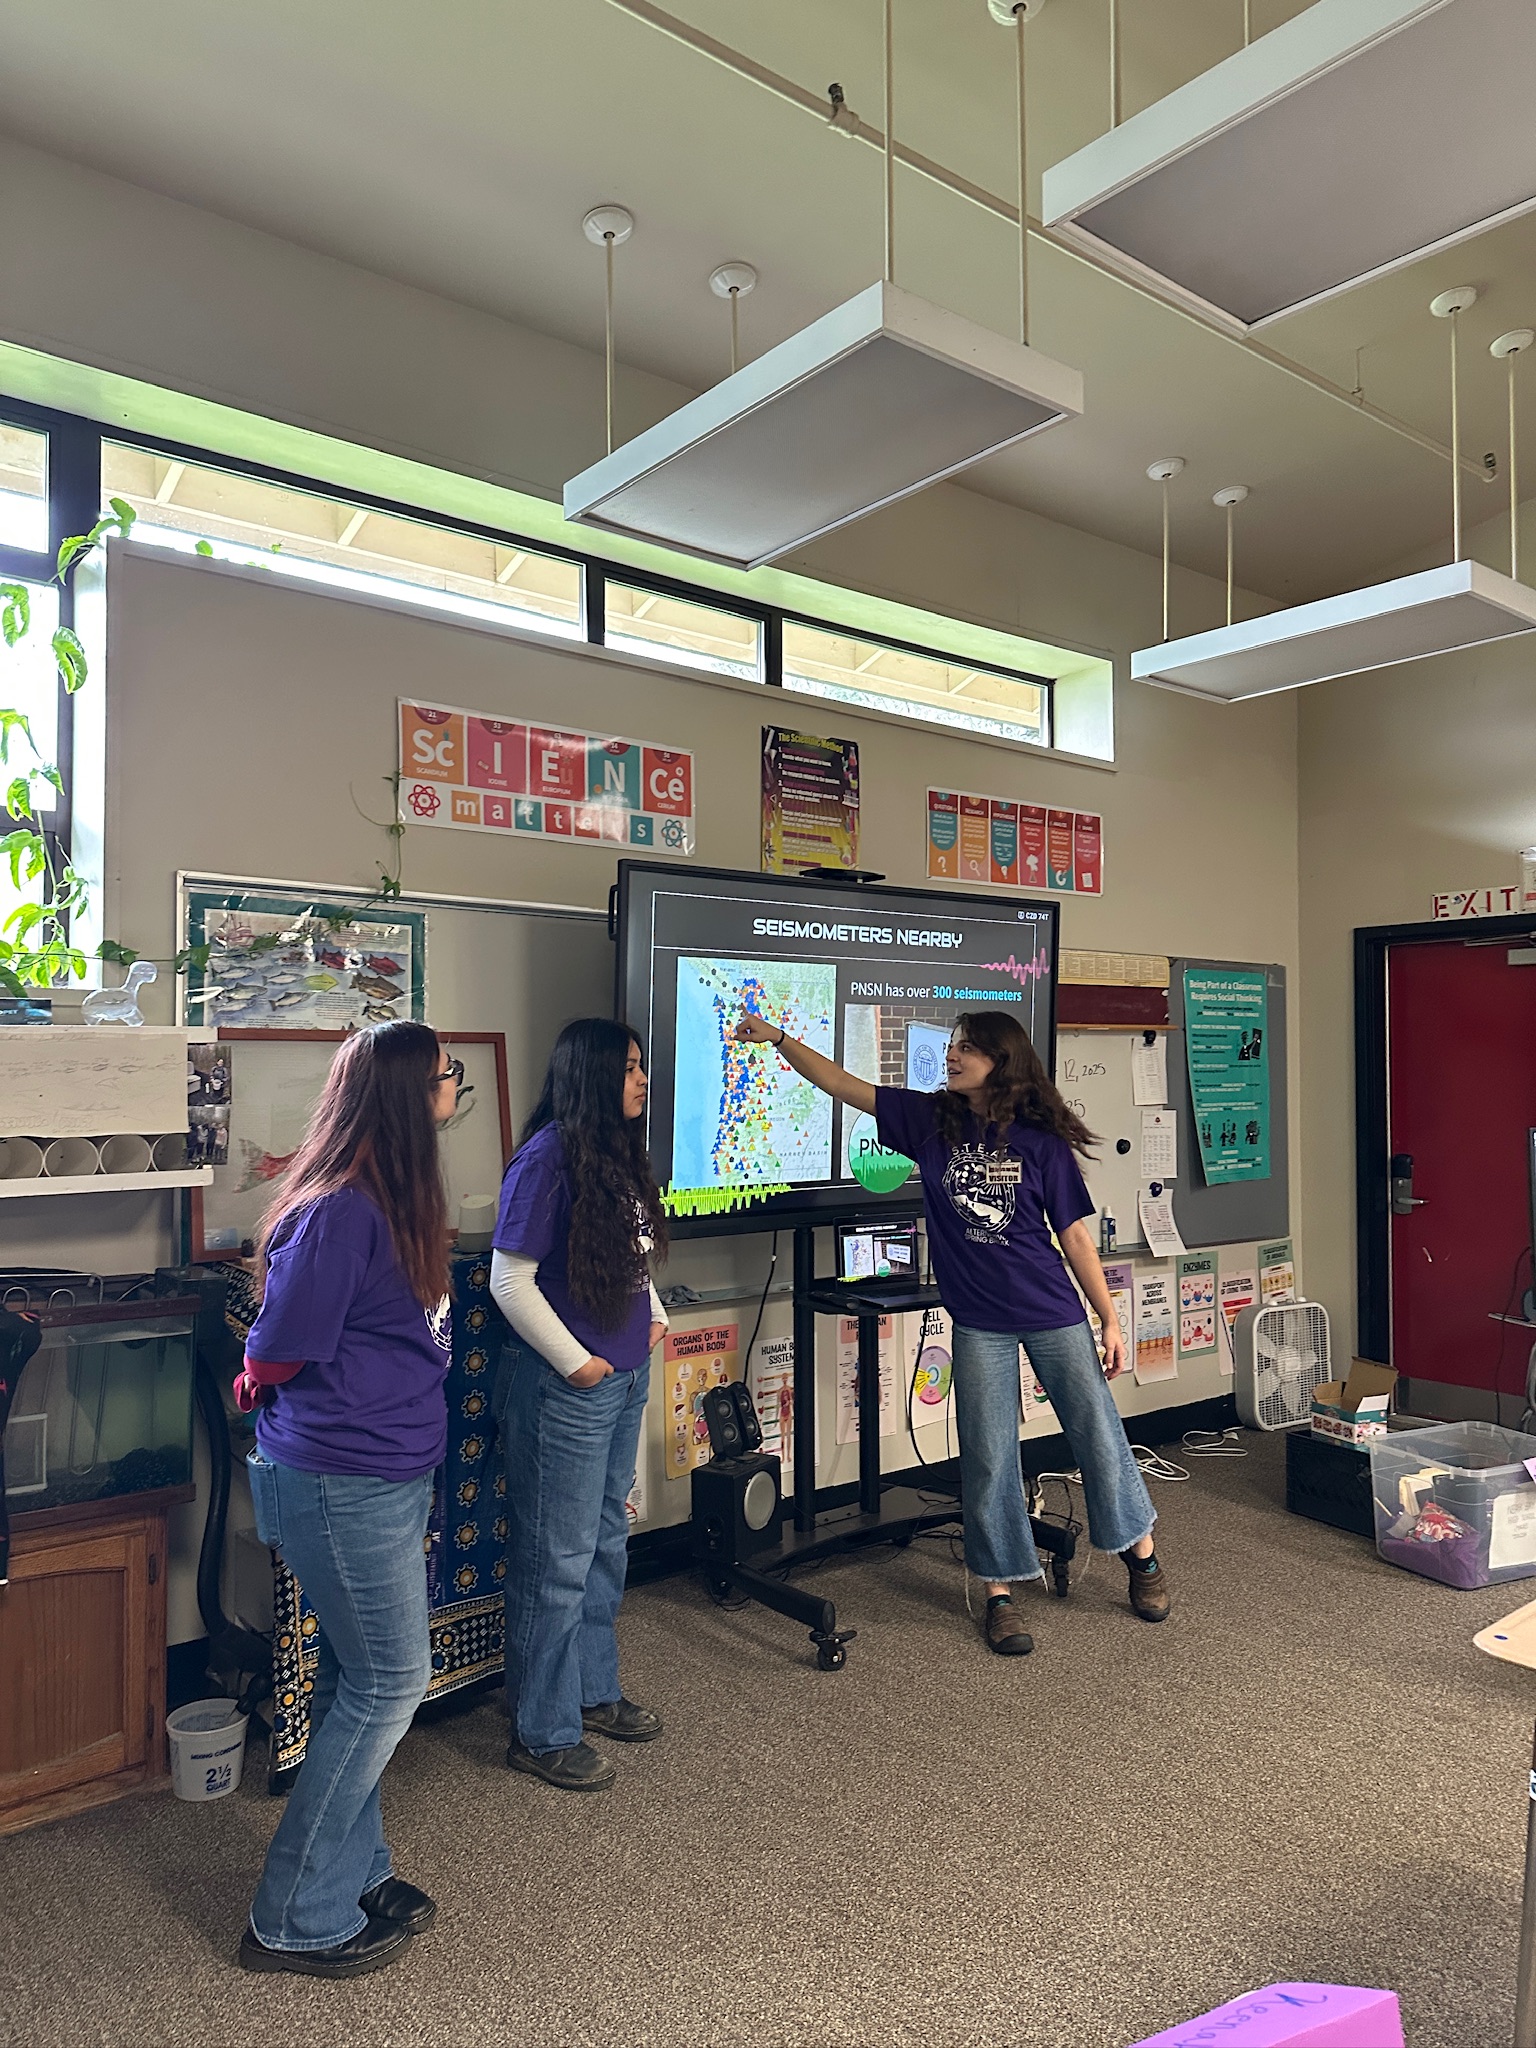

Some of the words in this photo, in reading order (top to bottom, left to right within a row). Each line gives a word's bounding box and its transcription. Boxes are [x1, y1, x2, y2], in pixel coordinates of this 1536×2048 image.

[778, 732, 790, 742] The
[1434, 888, 1516, 919] EXIT
[753, 918, 893, 944] SEISMOMETERS
[897, 928, 963, 948] NEARBY
[850, 981, 883, 997] PNSN
[885, 982, 904, 998] has
[907, 986, 931, 999] over
[932, 985, 952, 1000] 300
[953, 987, 1022, 1002] seismometers
[1189, 979, 1206, 991] Being
[1207, 980, 1220, 990] Part
[1220, 981, 1228, 990] of
[1232, 982, 1262, 991] Classroom
[1190, 991, 1218, 1003] Requires
[1217, 993, 1236, 1002] Social
[1236, 993, 1263, 1006] Thinking
[1082, 1063, 1106, 1077] 2025
[859, 1138, 900, 1157] PN
[1183, 1260, 1211, 1273] ENZYMES
[1142, 1281, 1165, 1290] TRANSPORT
[1222, 1278, 1251, 1288] CLASSIFICATION
[1146, 1289, 1162, 1298] ACROSS
[1141, 1296, 1167, 1306] MEMBRANES
[672, 1333, 702, 1347] ORGANS
[704, 1331, 714, 1341] OF
[716, 1329, 730, 1339] THE
[676, 1343, 704, 1357] HUMAN
[706, 1340, 726, 1352] BODY
[761, 1342, 787, 1356] HUMAN
[768, 1352, 794, 1365] SYSTEM
[206, 1777, 231, 1792] QUART
